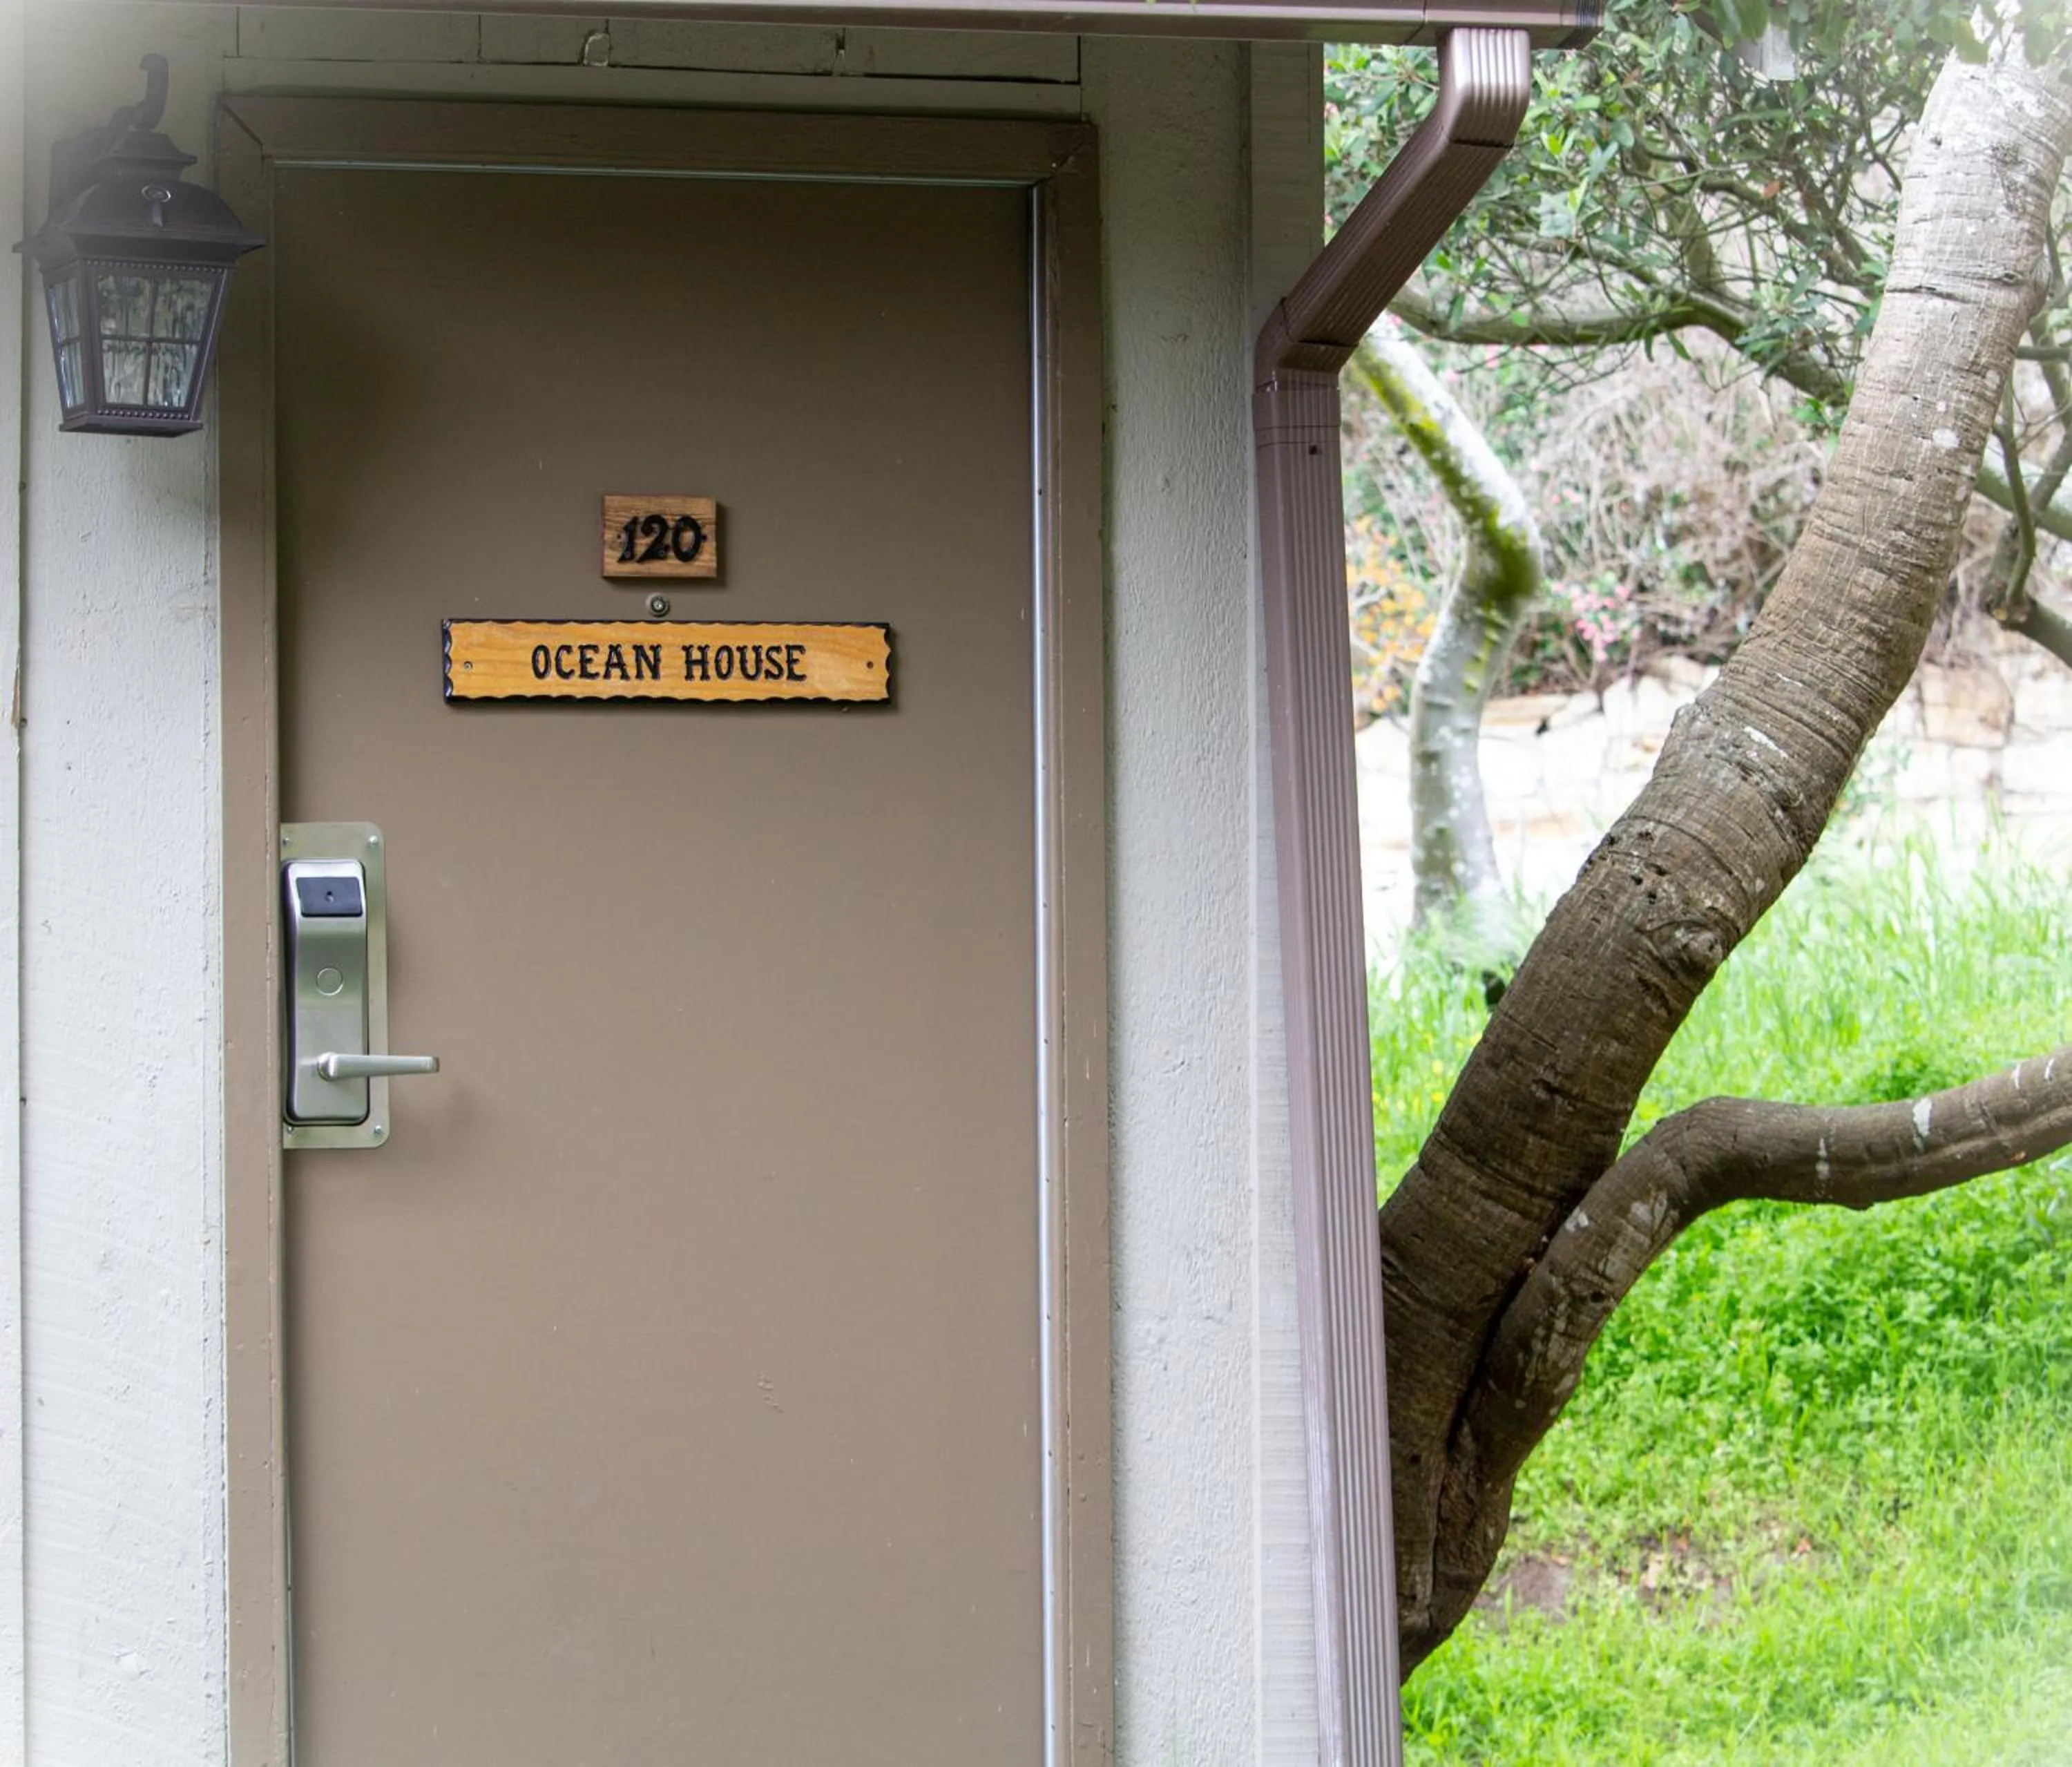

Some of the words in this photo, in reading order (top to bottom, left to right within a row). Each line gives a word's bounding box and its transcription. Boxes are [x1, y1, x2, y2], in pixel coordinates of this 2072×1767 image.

[617, 514, 704, 563] 120
[531, 644, 662, 682] OCEAN
[682, 644, 807, 682] HOUSE
